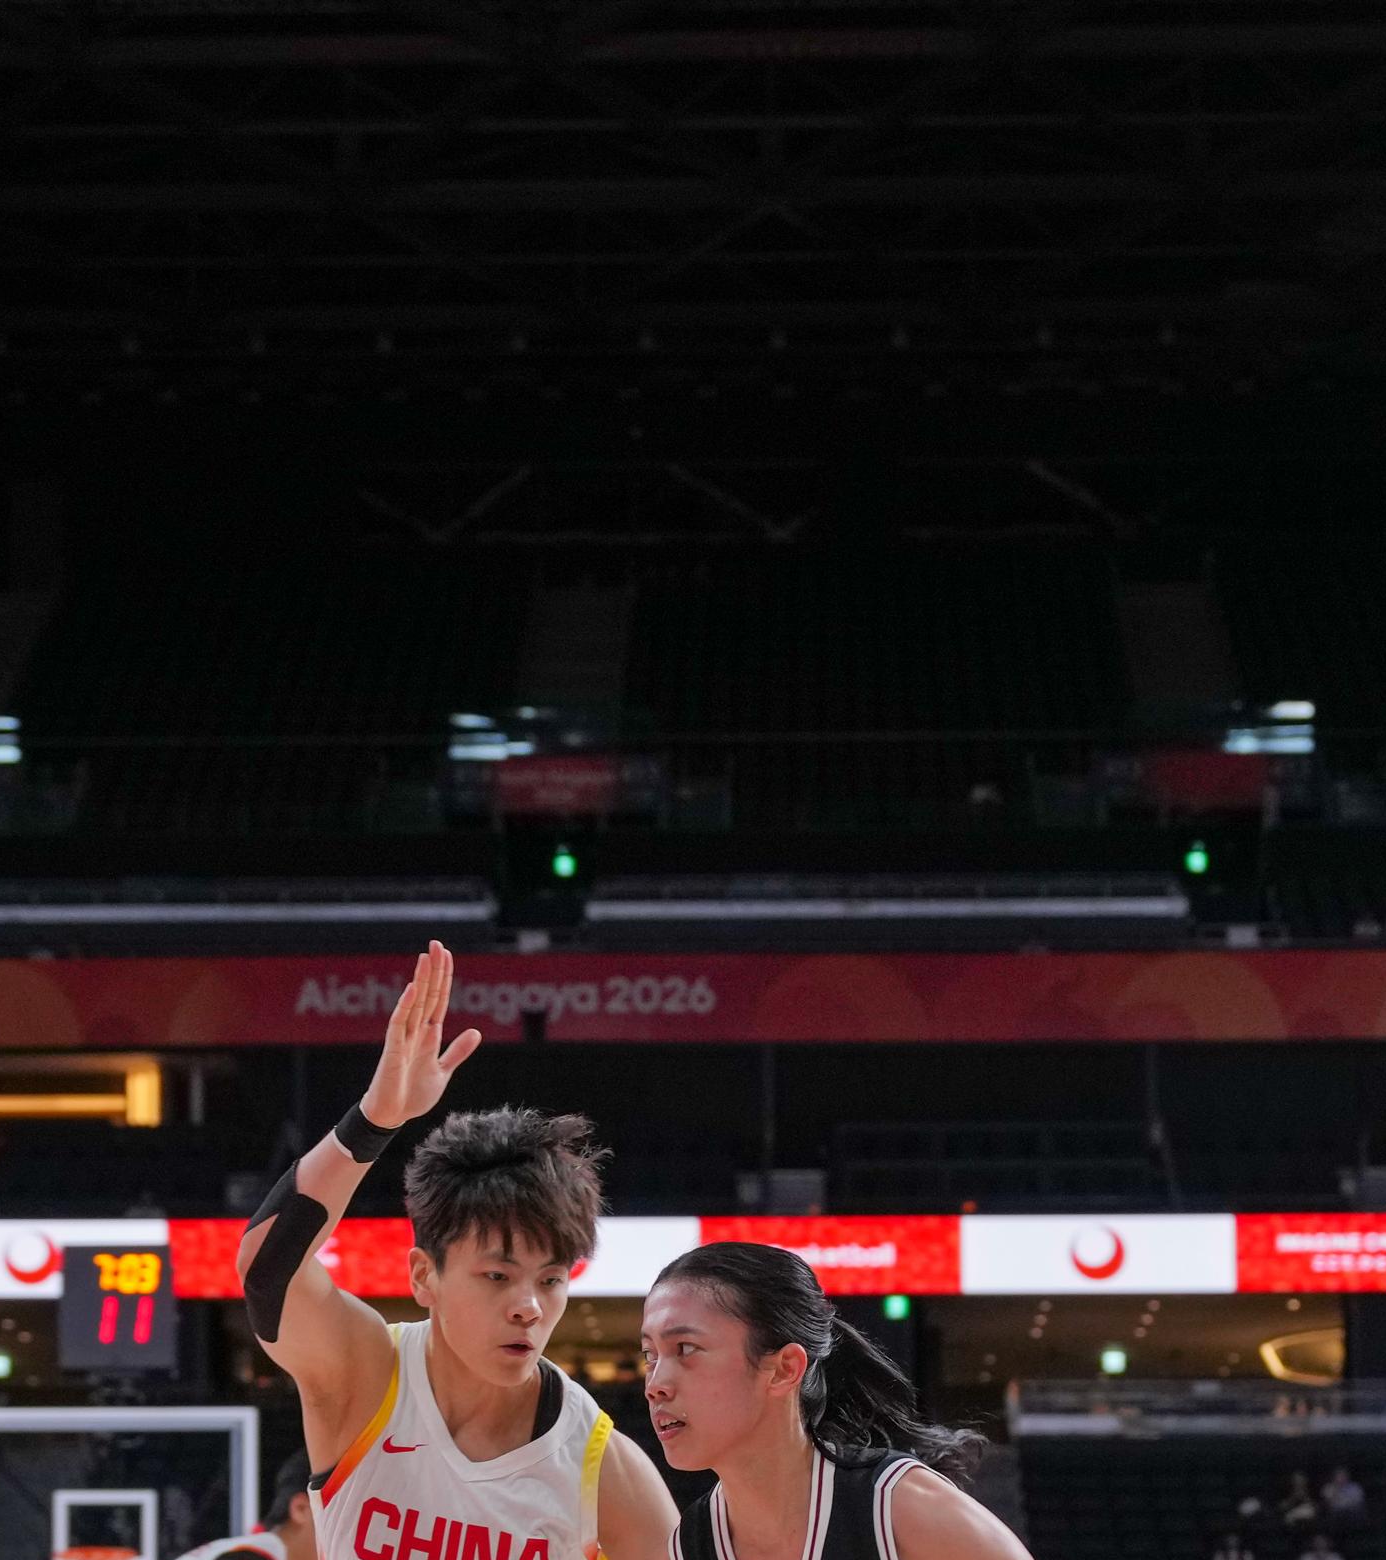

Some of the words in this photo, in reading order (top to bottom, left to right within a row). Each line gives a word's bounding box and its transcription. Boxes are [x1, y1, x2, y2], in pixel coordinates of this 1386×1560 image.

[604, 975, 714, 1015] 2026
[93, 1253, 162, 1294] 7:03
[98, 1295, 154, 1345] 11
